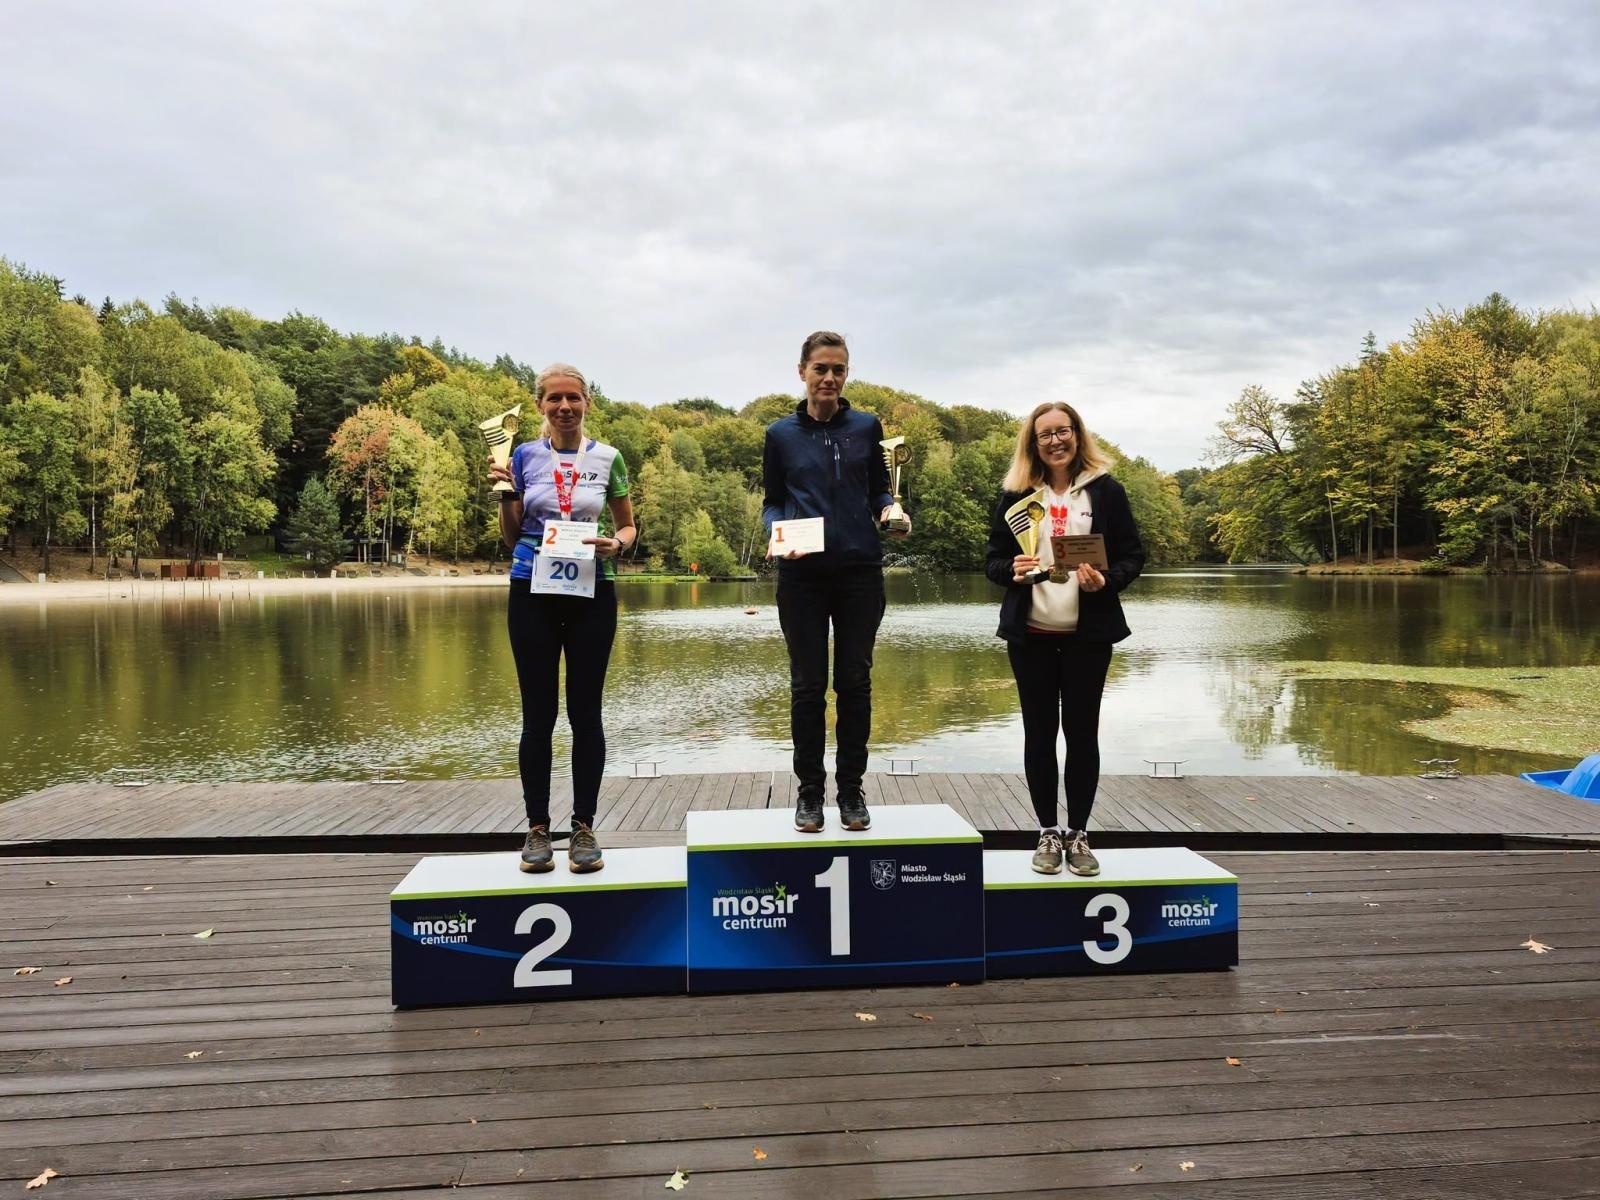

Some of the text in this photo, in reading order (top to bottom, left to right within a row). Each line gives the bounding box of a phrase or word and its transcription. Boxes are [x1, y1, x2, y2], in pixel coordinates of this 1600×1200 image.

[545, 527, 558, 545] 2
[775, 527, 785, 543] 1
[1055, 542, 1066, 559] 3
[549, 561, 579, 581] 20
[901, 864, 927, 872] Miasto
[901, 872, 966, 883] Wodzisław Śląski
[712, 889, 799, 917] mosir
[815, 856, 850, 956] 1
[1161, 901, 1219, 918] mosir
[413, 916, 477, 936] mosir
[722, 917, 787, 930] centrum
[1082, 893, 1133, 965] 3
[1168, 918, 1211, 927] centrum
[420, 934, 468, 945] centrum
[513, 903, 573, 988] 2
